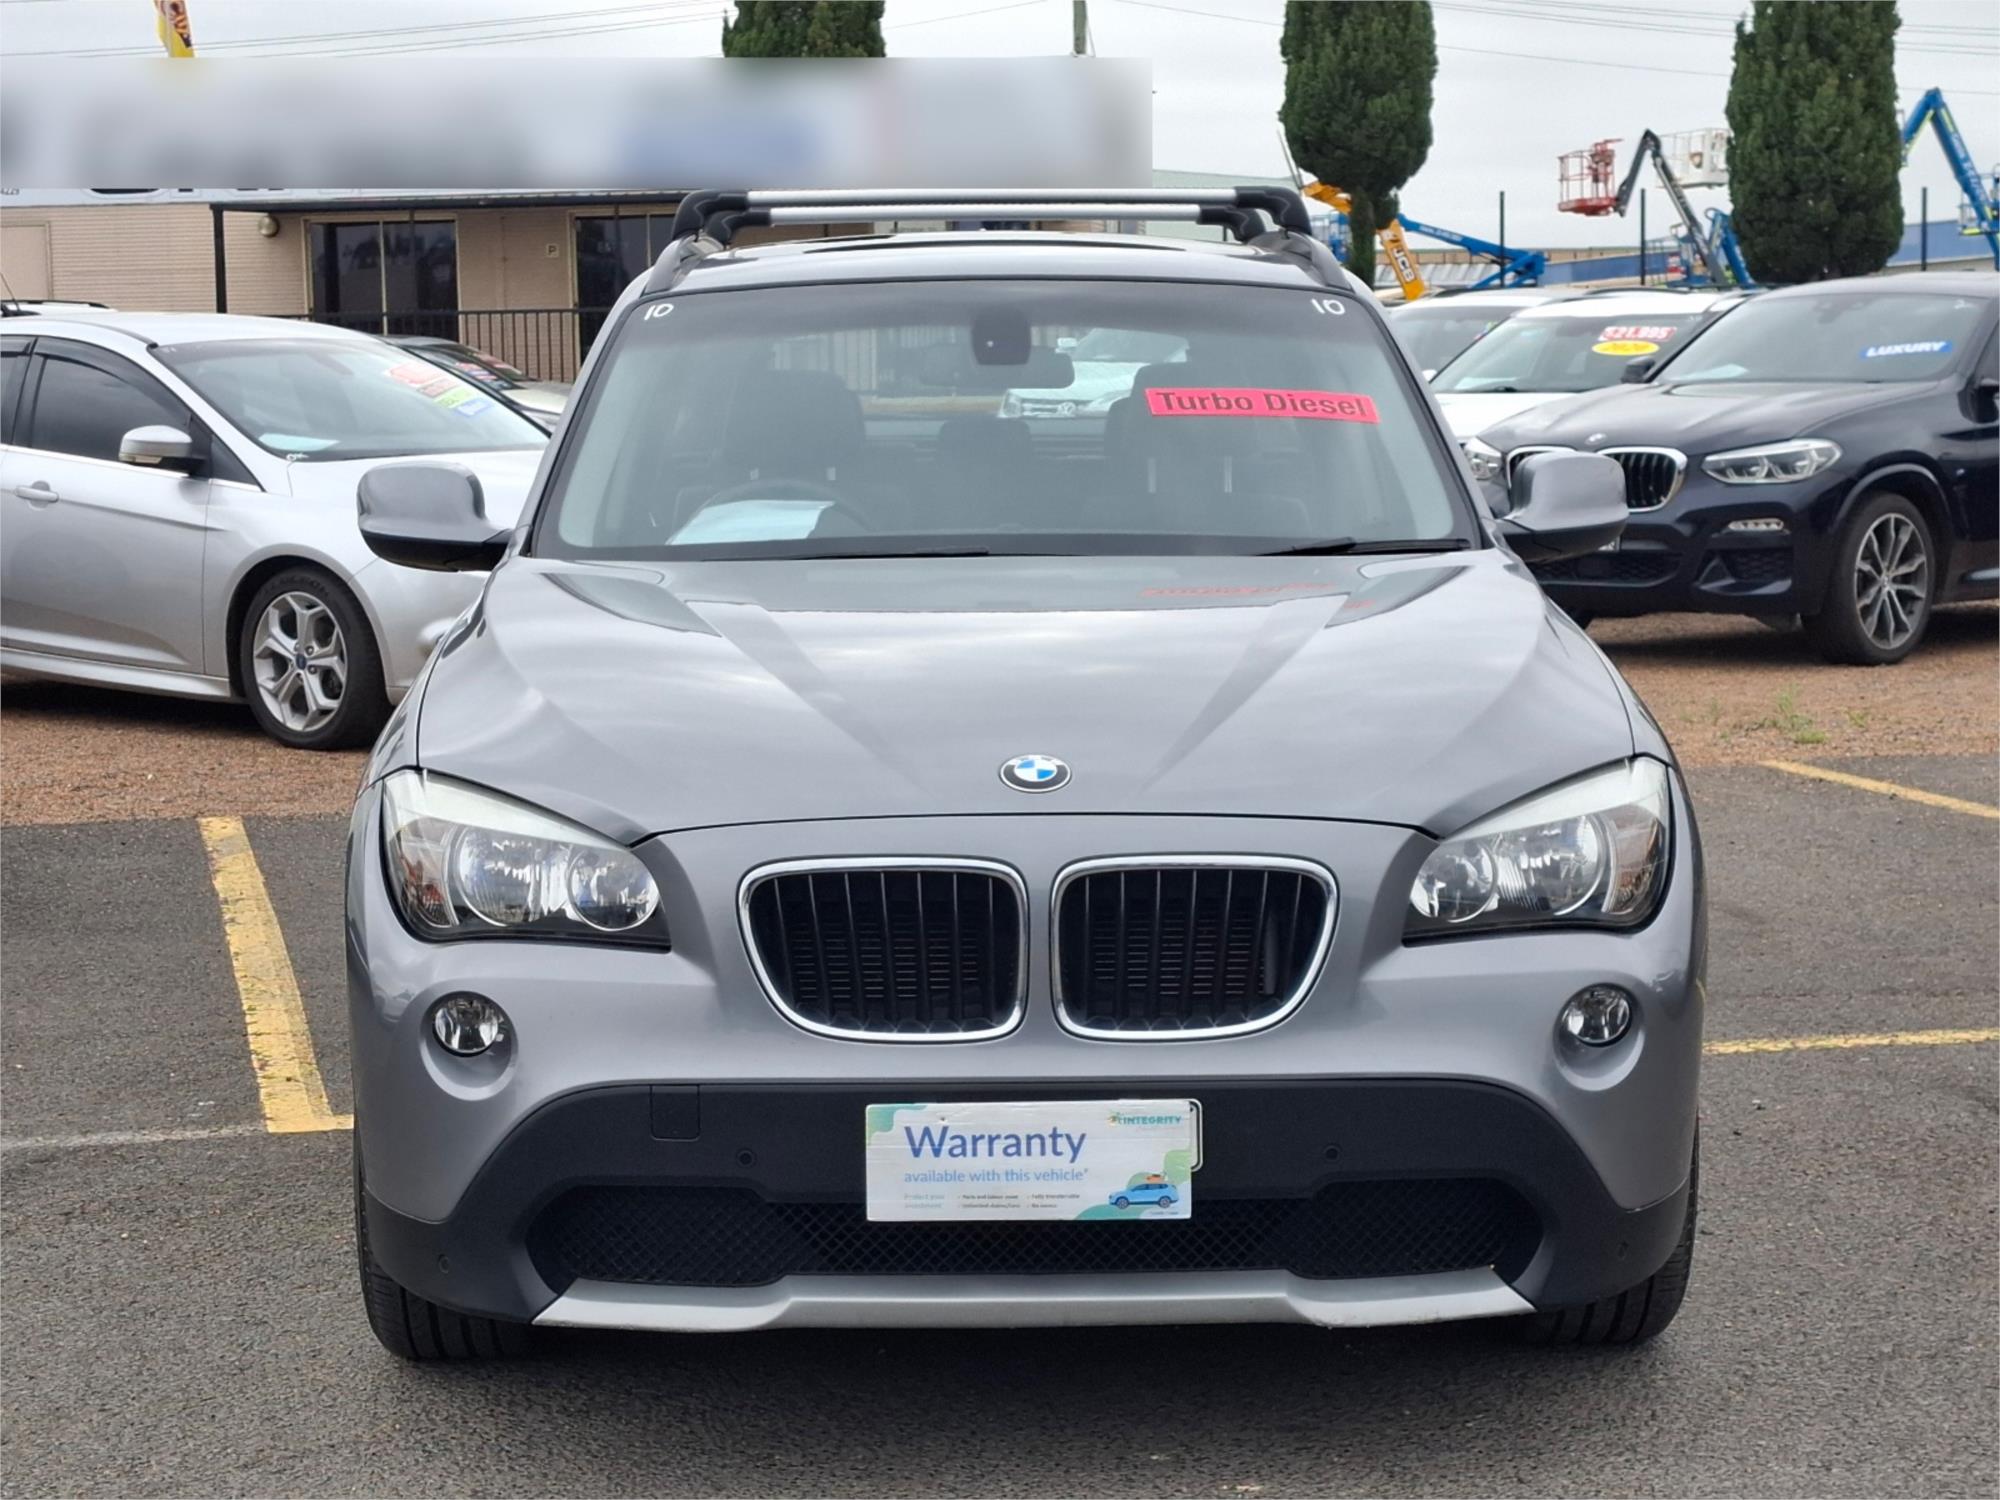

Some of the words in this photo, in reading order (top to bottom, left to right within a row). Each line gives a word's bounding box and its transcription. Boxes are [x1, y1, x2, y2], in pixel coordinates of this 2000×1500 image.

[1393, 247, 1415, 282] JCB
[644, 303, 674, 321] 10
[1311, 298, 1345, 315] 10
[1866, 341, 1947, 357] LUXURY
[1156, 391, 1253, 411] Turbo
[1263, 392, 1368, 417] Diesel
[1122, 1115, 1182, 1125] INTEGRITY
[904, 1125, 1087, 1164] Warranty
[904, 1168, 965, 1182] available
[969, 1167, 1000, 1182] with
[1004, 1167, 1030, 1181] this
